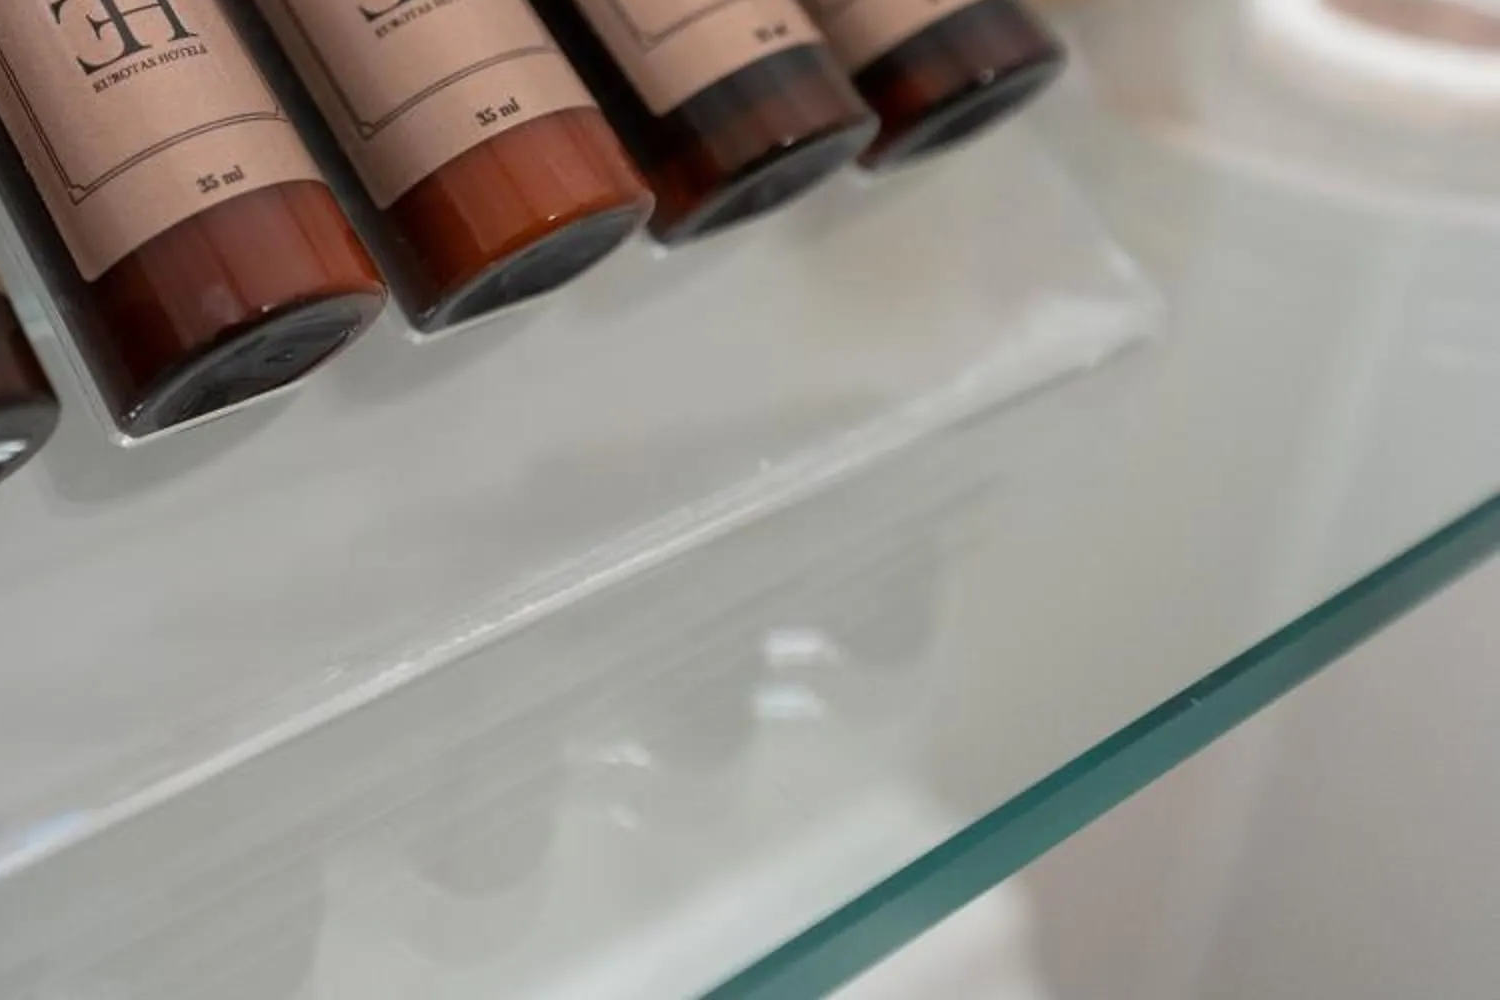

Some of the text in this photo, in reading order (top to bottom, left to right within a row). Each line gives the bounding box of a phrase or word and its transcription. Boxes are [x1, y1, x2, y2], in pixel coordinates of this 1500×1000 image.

[92, 43, 209, 94] EUROTAS HOTELS
[498, 96, 521, 117] ml
[196, 164, 245, 194] 35 ml
